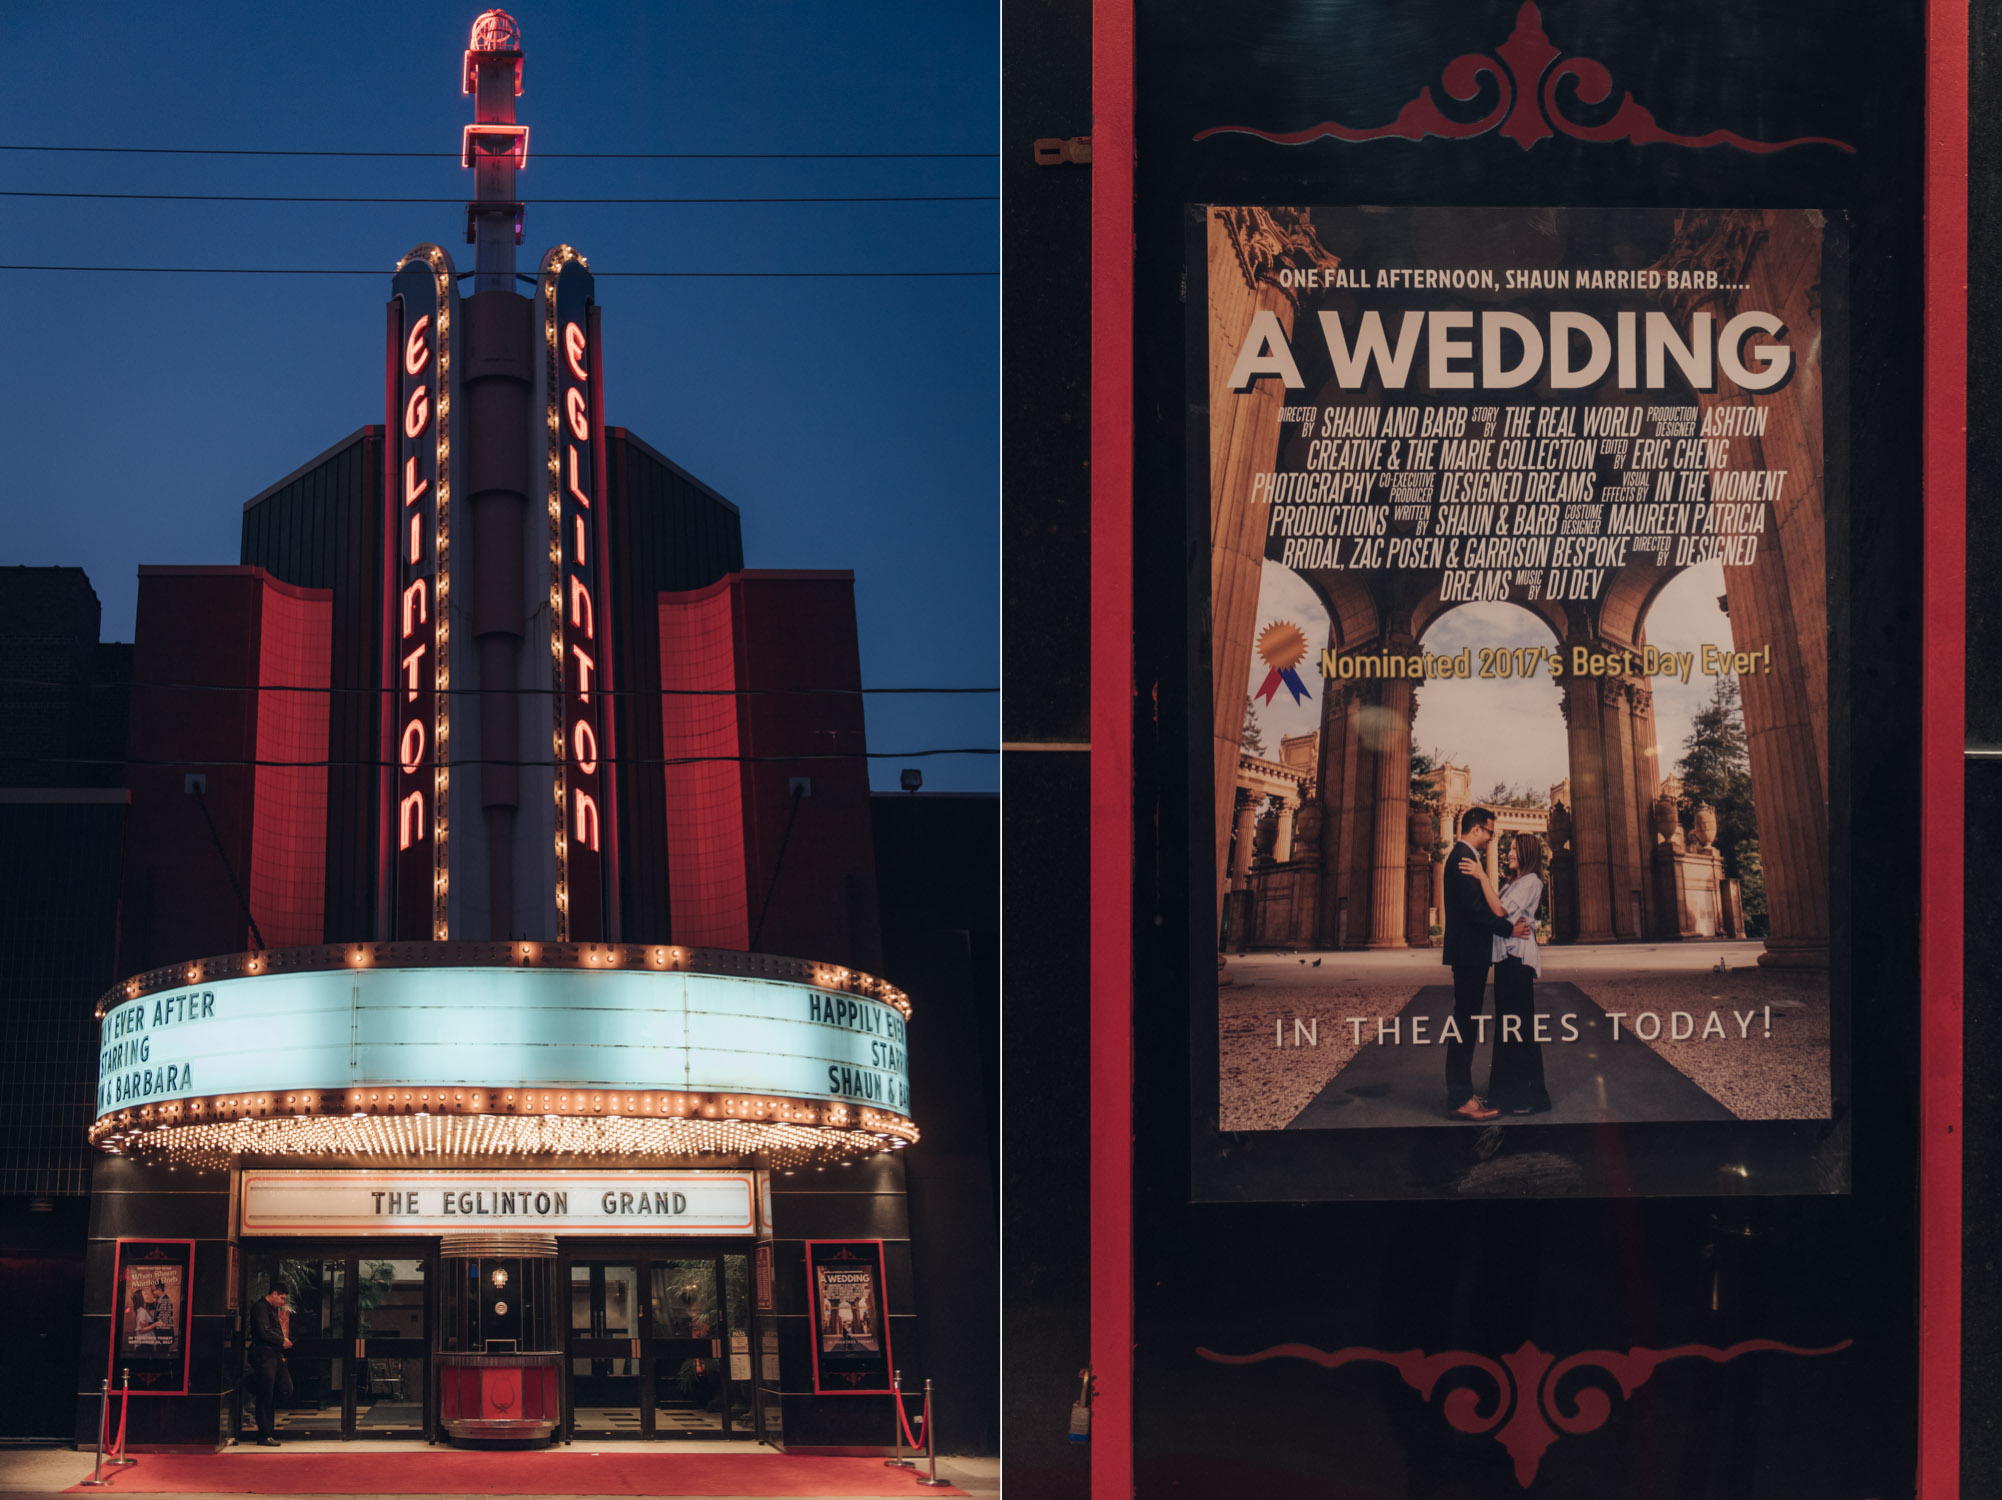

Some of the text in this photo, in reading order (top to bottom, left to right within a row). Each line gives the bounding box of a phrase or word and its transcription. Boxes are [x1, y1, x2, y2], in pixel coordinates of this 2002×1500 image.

[1279, 268, 1319, 289] ONE
[1324, 268, 1371, 289] FALL
[1376, 269, 1500, 292] AFTERNOON,
[1505, 269, 1569, 289] SHAUN
[1575, 269, 1661, 289] MARRIED
[1226, 310, 1791, 391] A WEDDING
[1277, 406, 1769, 438] DIRECTED BY SHAUN AND BARB STORY BY THE REAL WORLD PRODUCTION DESIGNER ASHTON
[1306, 439, 1730, 470] CREATIVE & THE MARIE COLLECTION EDITED BY ERIC CHENG
[1250, 470, 1788, 504] PHOTOGRAPHY CO-EXECUTIVE PRODUCER DESIGNED DREAMS VISUAL EFFECTS BY IN THE MOMENT
[1269, 503, 1766, 537] PRODUCTIONS WRITTEN BY SHAUN & BARB COSTUME DESIGNER MAUREEN PATRICIA
[1281, 535, 1759, 571] BRIDAL, ZAC POSEN & GARRISON BESPOKE DIRECTED BY DESIGNED
[1440, 569, 1605, 602] DREAMS MUSIC BY DJ DEV
[1320, 643, 1771, 684] Nominated 2017's Best Day Ever!
[114, 1004, 145, 1039] EVER
[152, 990, 215, 1028] AFTER
[808, 993, 882, 1034] HAPPILY
[1275, 1005, 1773, 1047] IN THEATRES TODAY!
[100, 1035, 150, 1079] STARRING
[116, 1062, 193, 1103] BARBARA
[828, 1064, 882, 1101] SHAUN
[888, 1076, 895, 1104] &
[371, 1191, 687, 1215] THE EGLINTON GRAND
[827, 1274, 870, 1283] WEDDING
